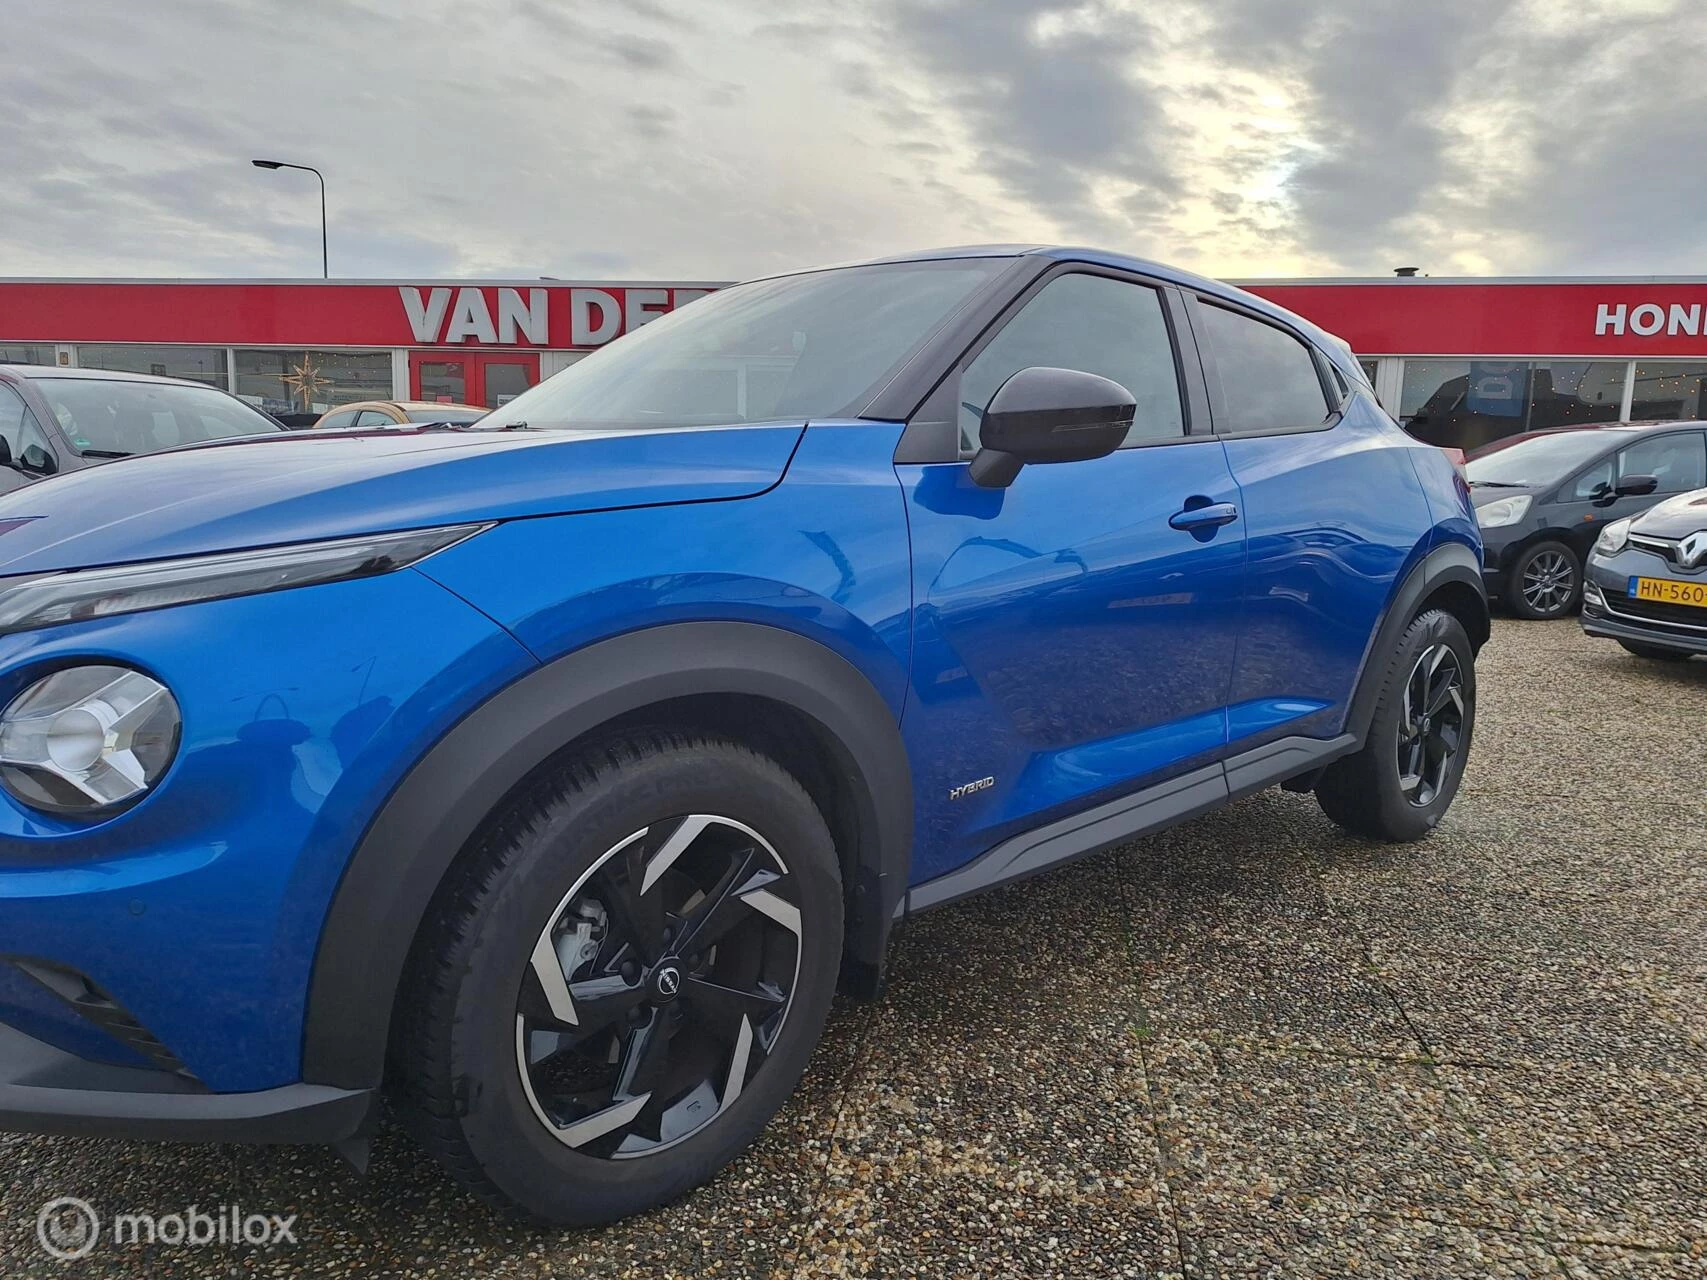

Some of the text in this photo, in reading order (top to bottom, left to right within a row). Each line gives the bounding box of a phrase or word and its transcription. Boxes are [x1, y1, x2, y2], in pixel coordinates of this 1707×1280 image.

[398, 287, 712, 345] VAN DE
[1594, 303, 1707, 336] HON
[949, 776, 995, 801] HYBRID
